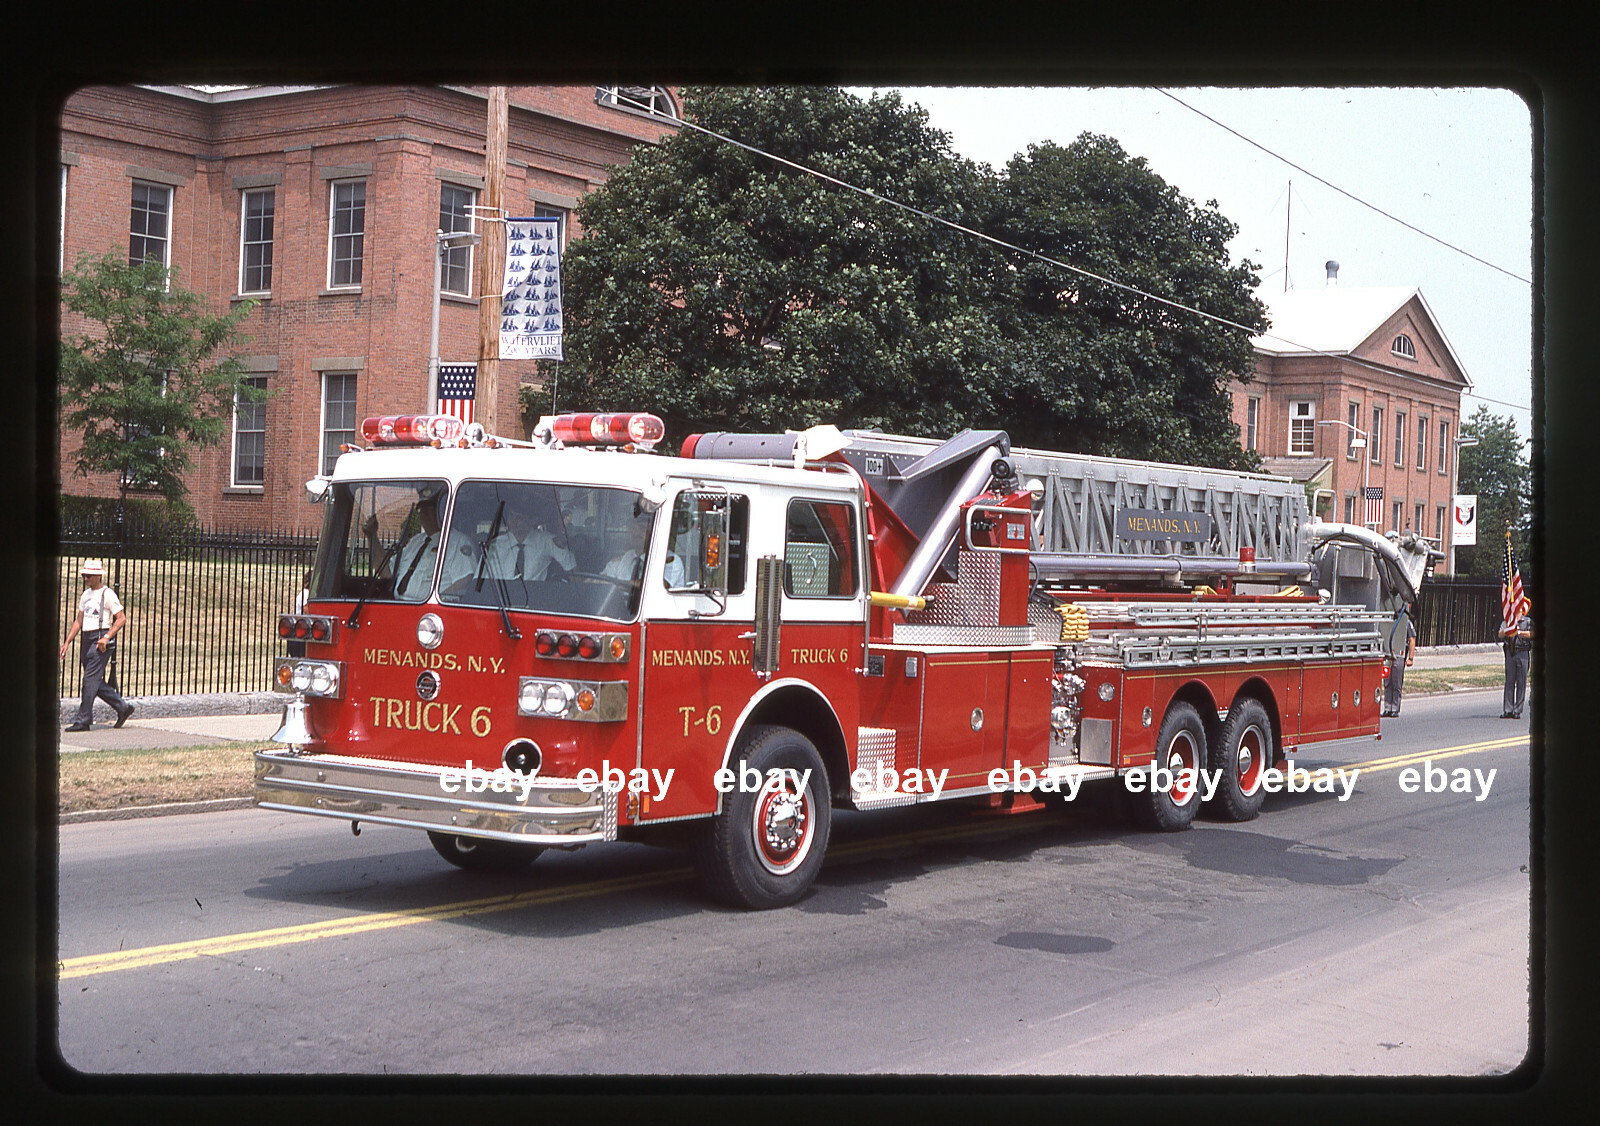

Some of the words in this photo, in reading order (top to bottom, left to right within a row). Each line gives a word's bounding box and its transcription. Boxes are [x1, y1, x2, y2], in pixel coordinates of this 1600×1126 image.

[1183, 519, 1201, 534] N.Y.
[364, 648, 462, 672] MENANDS,
[467, 655, 506, 674] N.Y.
[652, 649, 725, 667] MENANDS,
[728, 649, 750, 666] N.Y.
[791, 648, 836, 664] TRUCK
[839, 648, 848, 663] 6
[369, 696, 462, 736] TRUCK
[470, 706, 493, 737] 6
[678, 705, 722, 737] T-6
